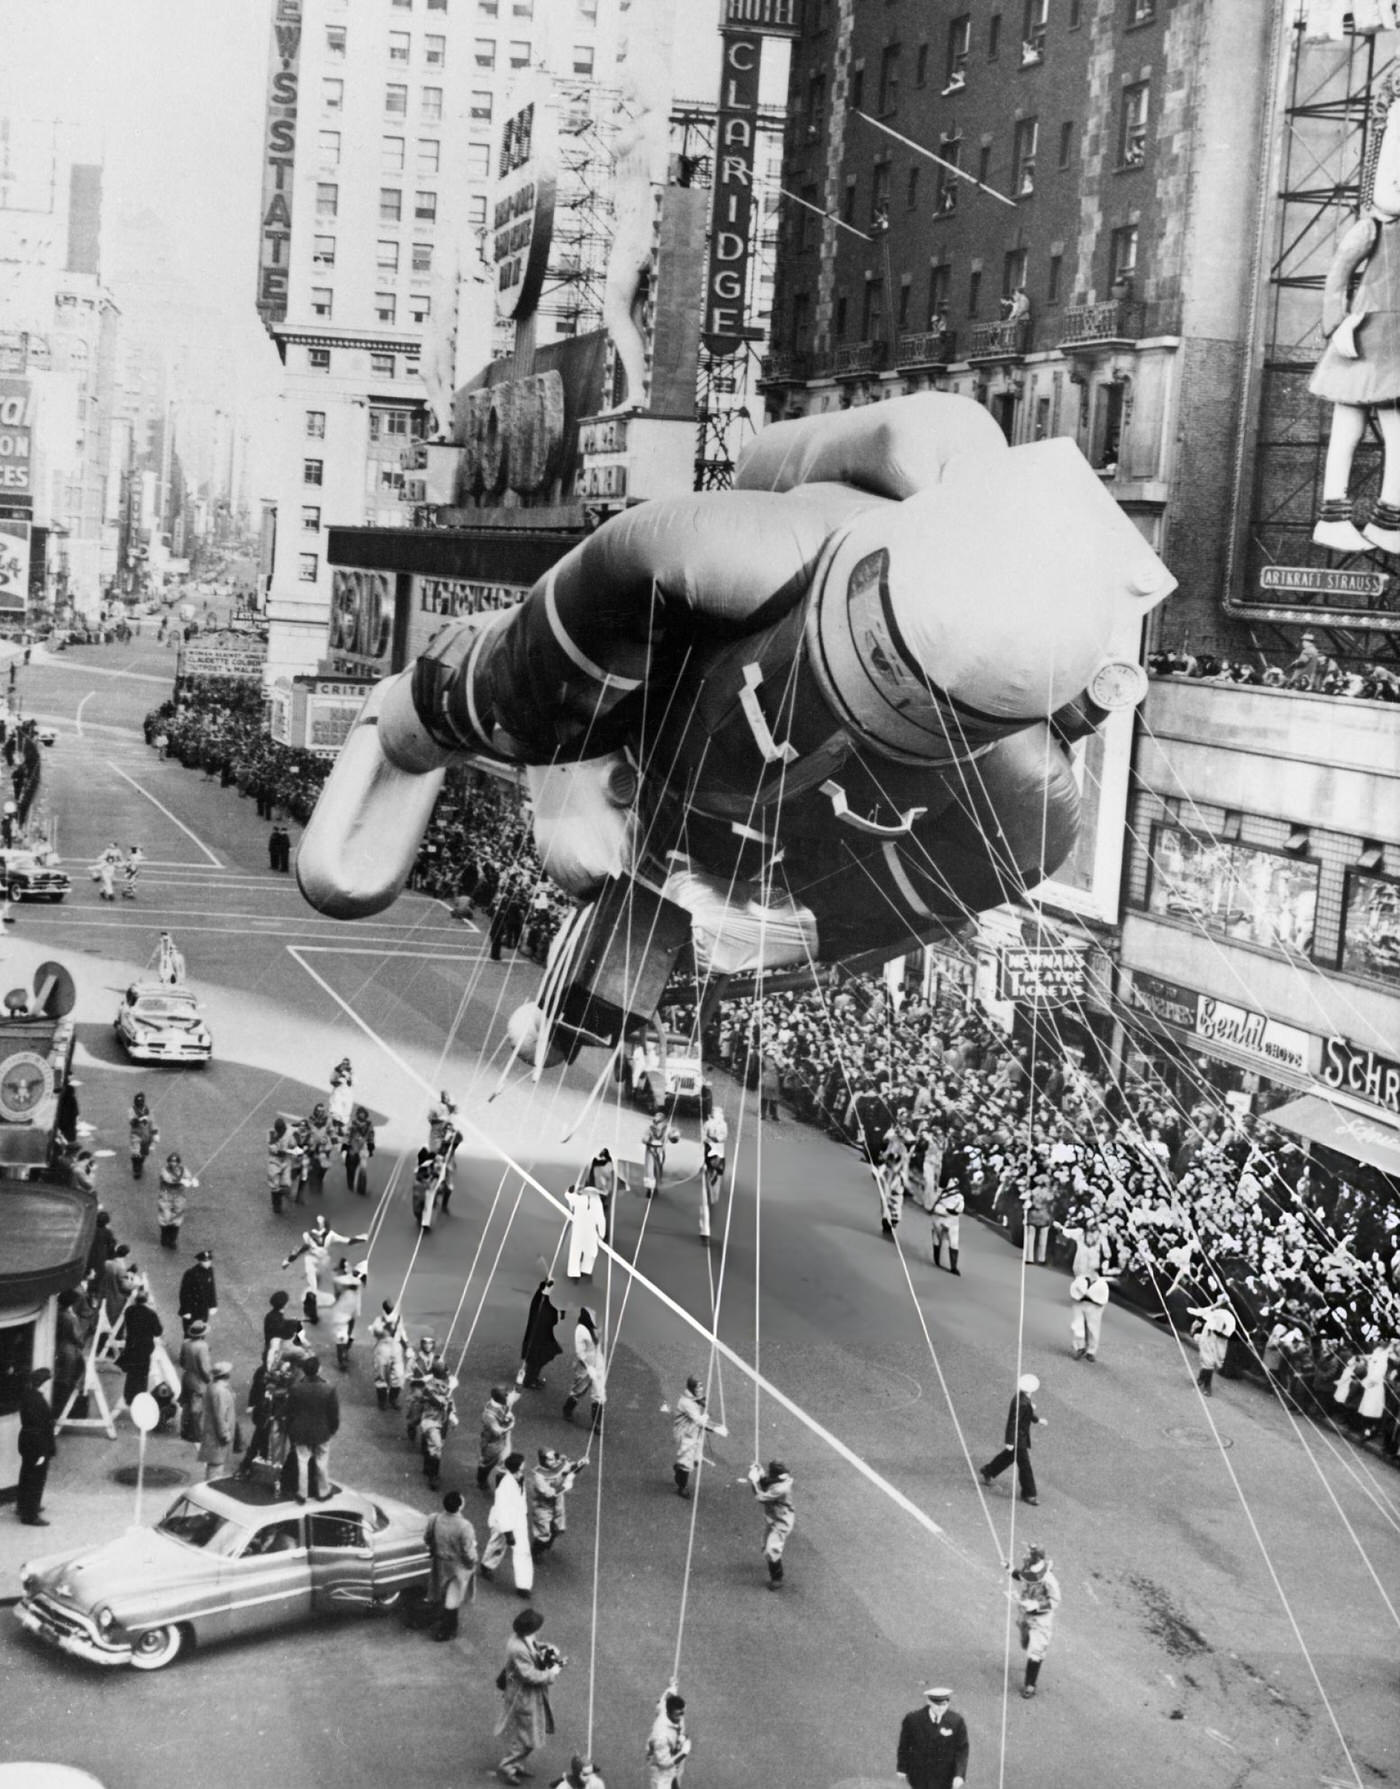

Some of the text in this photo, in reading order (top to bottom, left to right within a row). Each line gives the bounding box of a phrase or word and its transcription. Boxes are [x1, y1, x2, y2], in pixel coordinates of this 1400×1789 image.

[262, 120, 296, 301] STATE
[712, 41, 756, 335] CLARIDGE
[1264, 570, 1380, 592] ARTKRAFT STRAUSS
[1011, 985, 1084, 997] TICKETS
